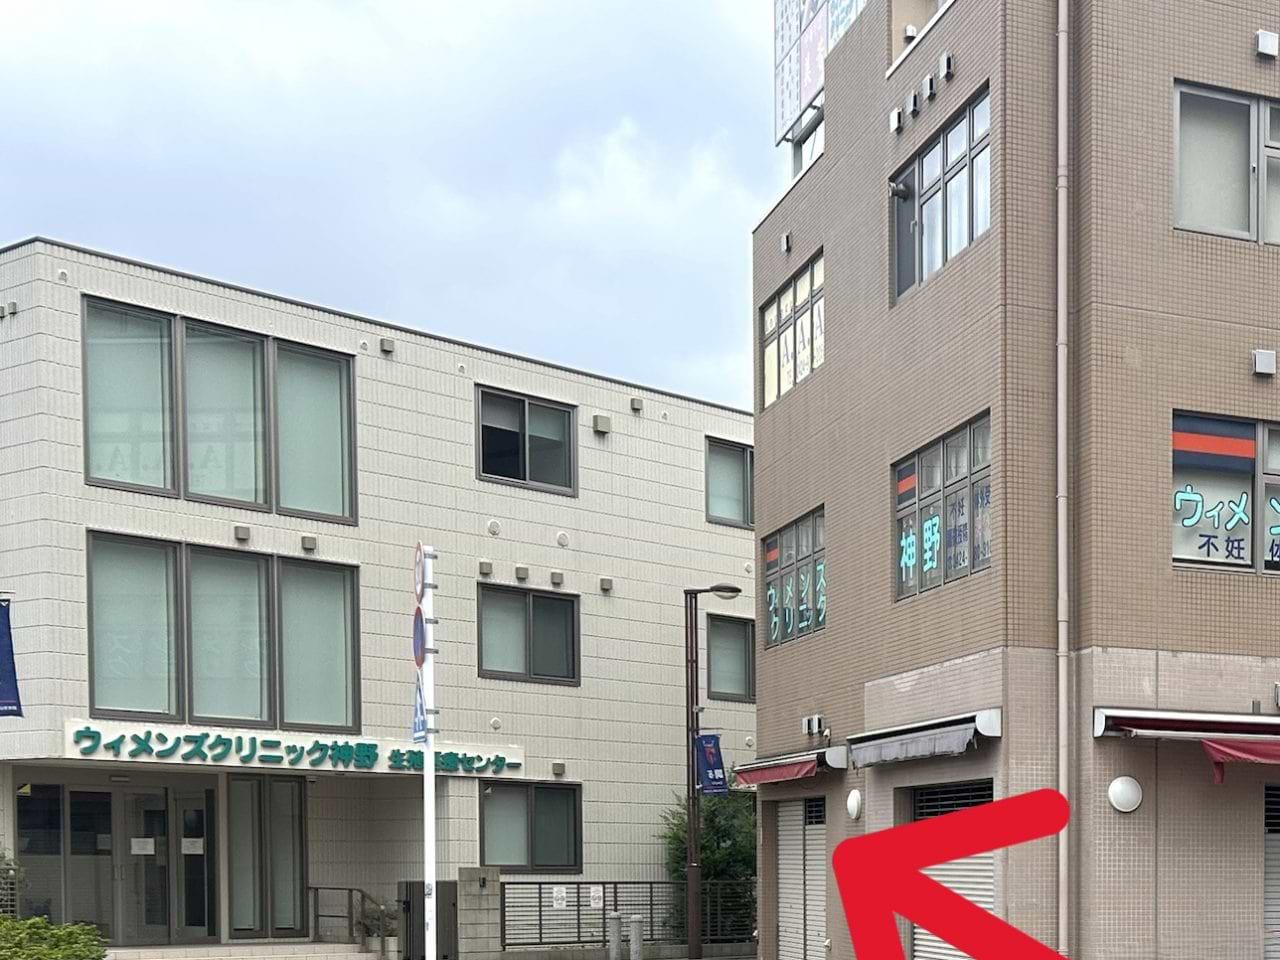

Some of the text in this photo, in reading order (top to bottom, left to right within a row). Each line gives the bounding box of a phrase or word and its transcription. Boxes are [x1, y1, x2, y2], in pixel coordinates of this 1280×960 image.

[900, 515, 941, 577] 神野
[1198, 534, 1246, 562] 不妊
[73, 725, 379, 769] ウィメンズクリニック神野
